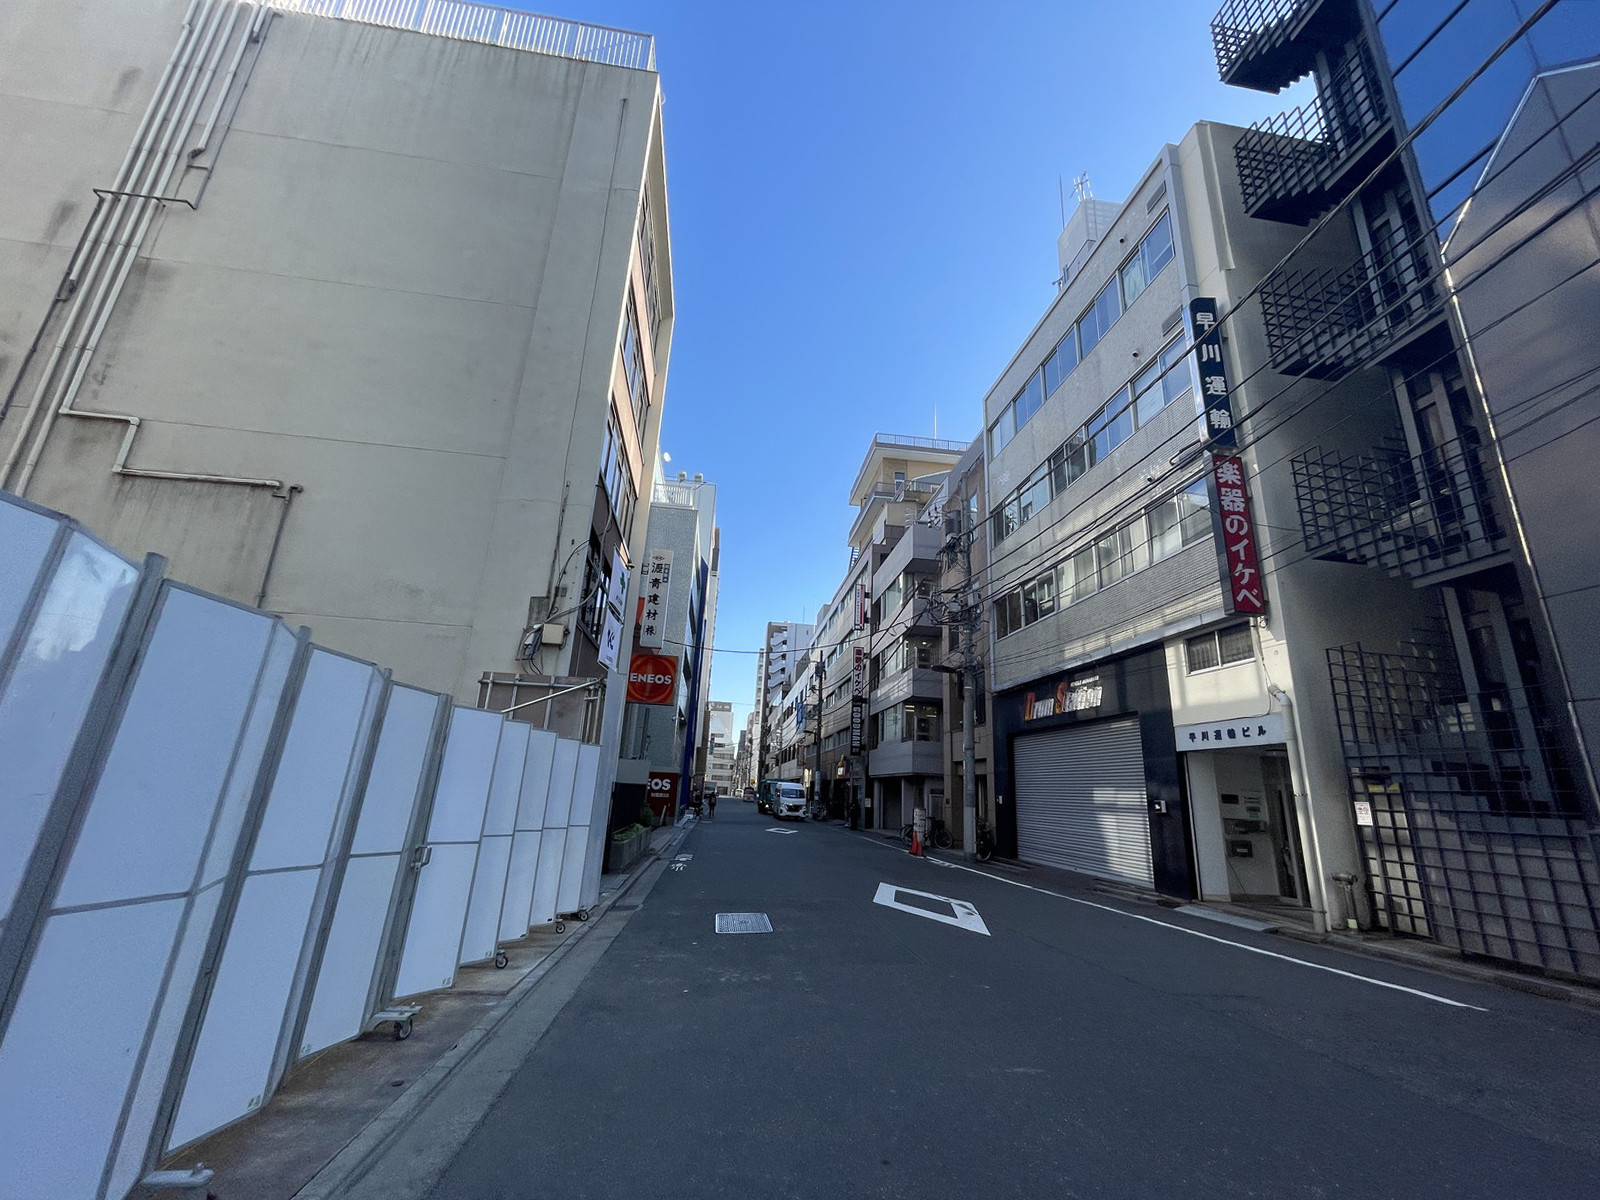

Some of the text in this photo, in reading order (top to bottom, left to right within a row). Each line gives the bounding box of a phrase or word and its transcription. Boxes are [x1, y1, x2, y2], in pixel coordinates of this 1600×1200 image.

[1196, 312, 1232, 429] 早川運輸
[1216, 461, 1261, 608] 楽器のイケベ
[629, 672, 672, 685] ENEOS
[852, 706, 861, 747] GOODMAN
